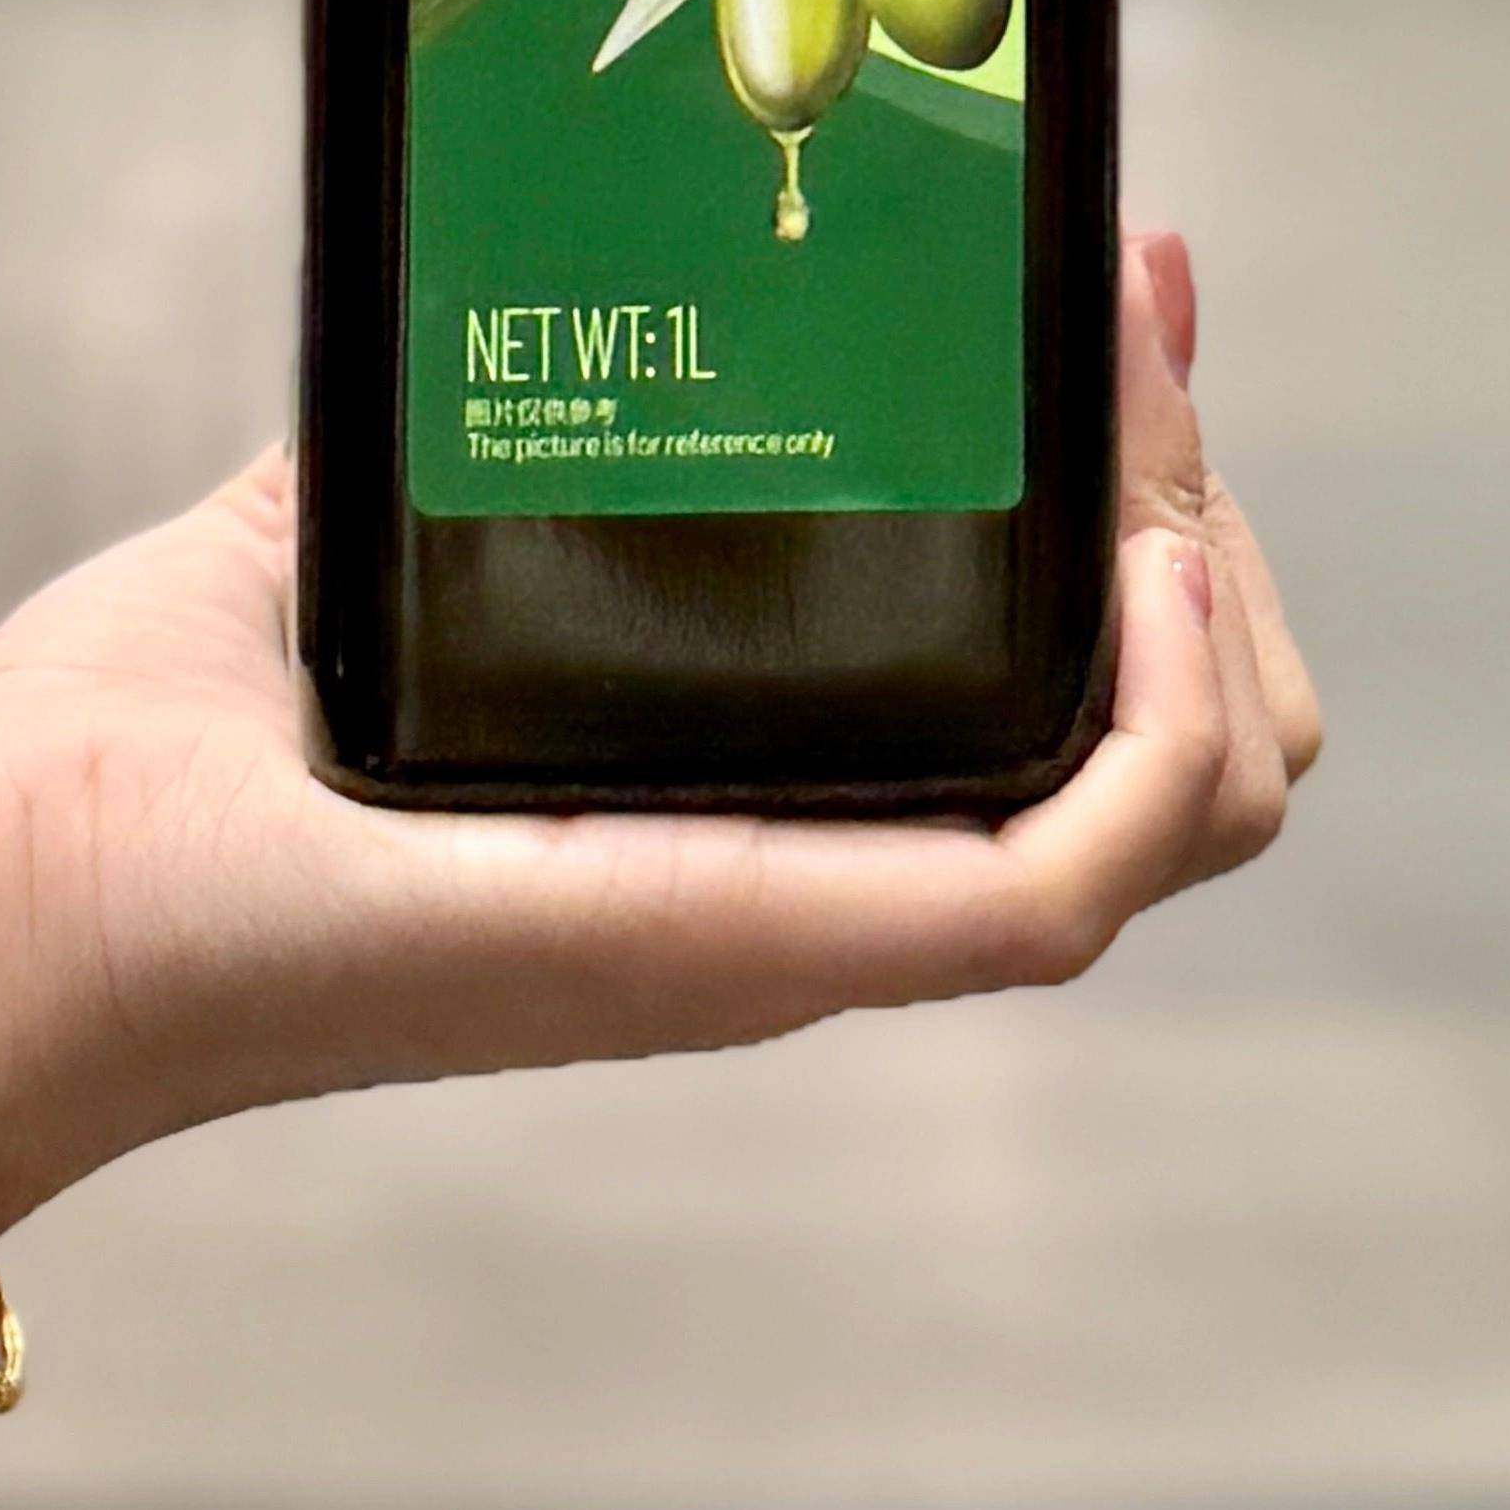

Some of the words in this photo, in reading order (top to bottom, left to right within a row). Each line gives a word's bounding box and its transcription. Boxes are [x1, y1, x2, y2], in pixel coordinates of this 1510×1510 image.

[467, 306, 562, 383] NET
[572, 305, 656, 380] WT:
[665, 304, 717, 380] 1L
[468, 432, 512, 460] The
[514, 432, 598, 464] picture
[602, 431, 624, 457] is
[627, 429, 660, 457] for
[664, 428, 783, 457] reference
[785, 429, 834, 459] only
